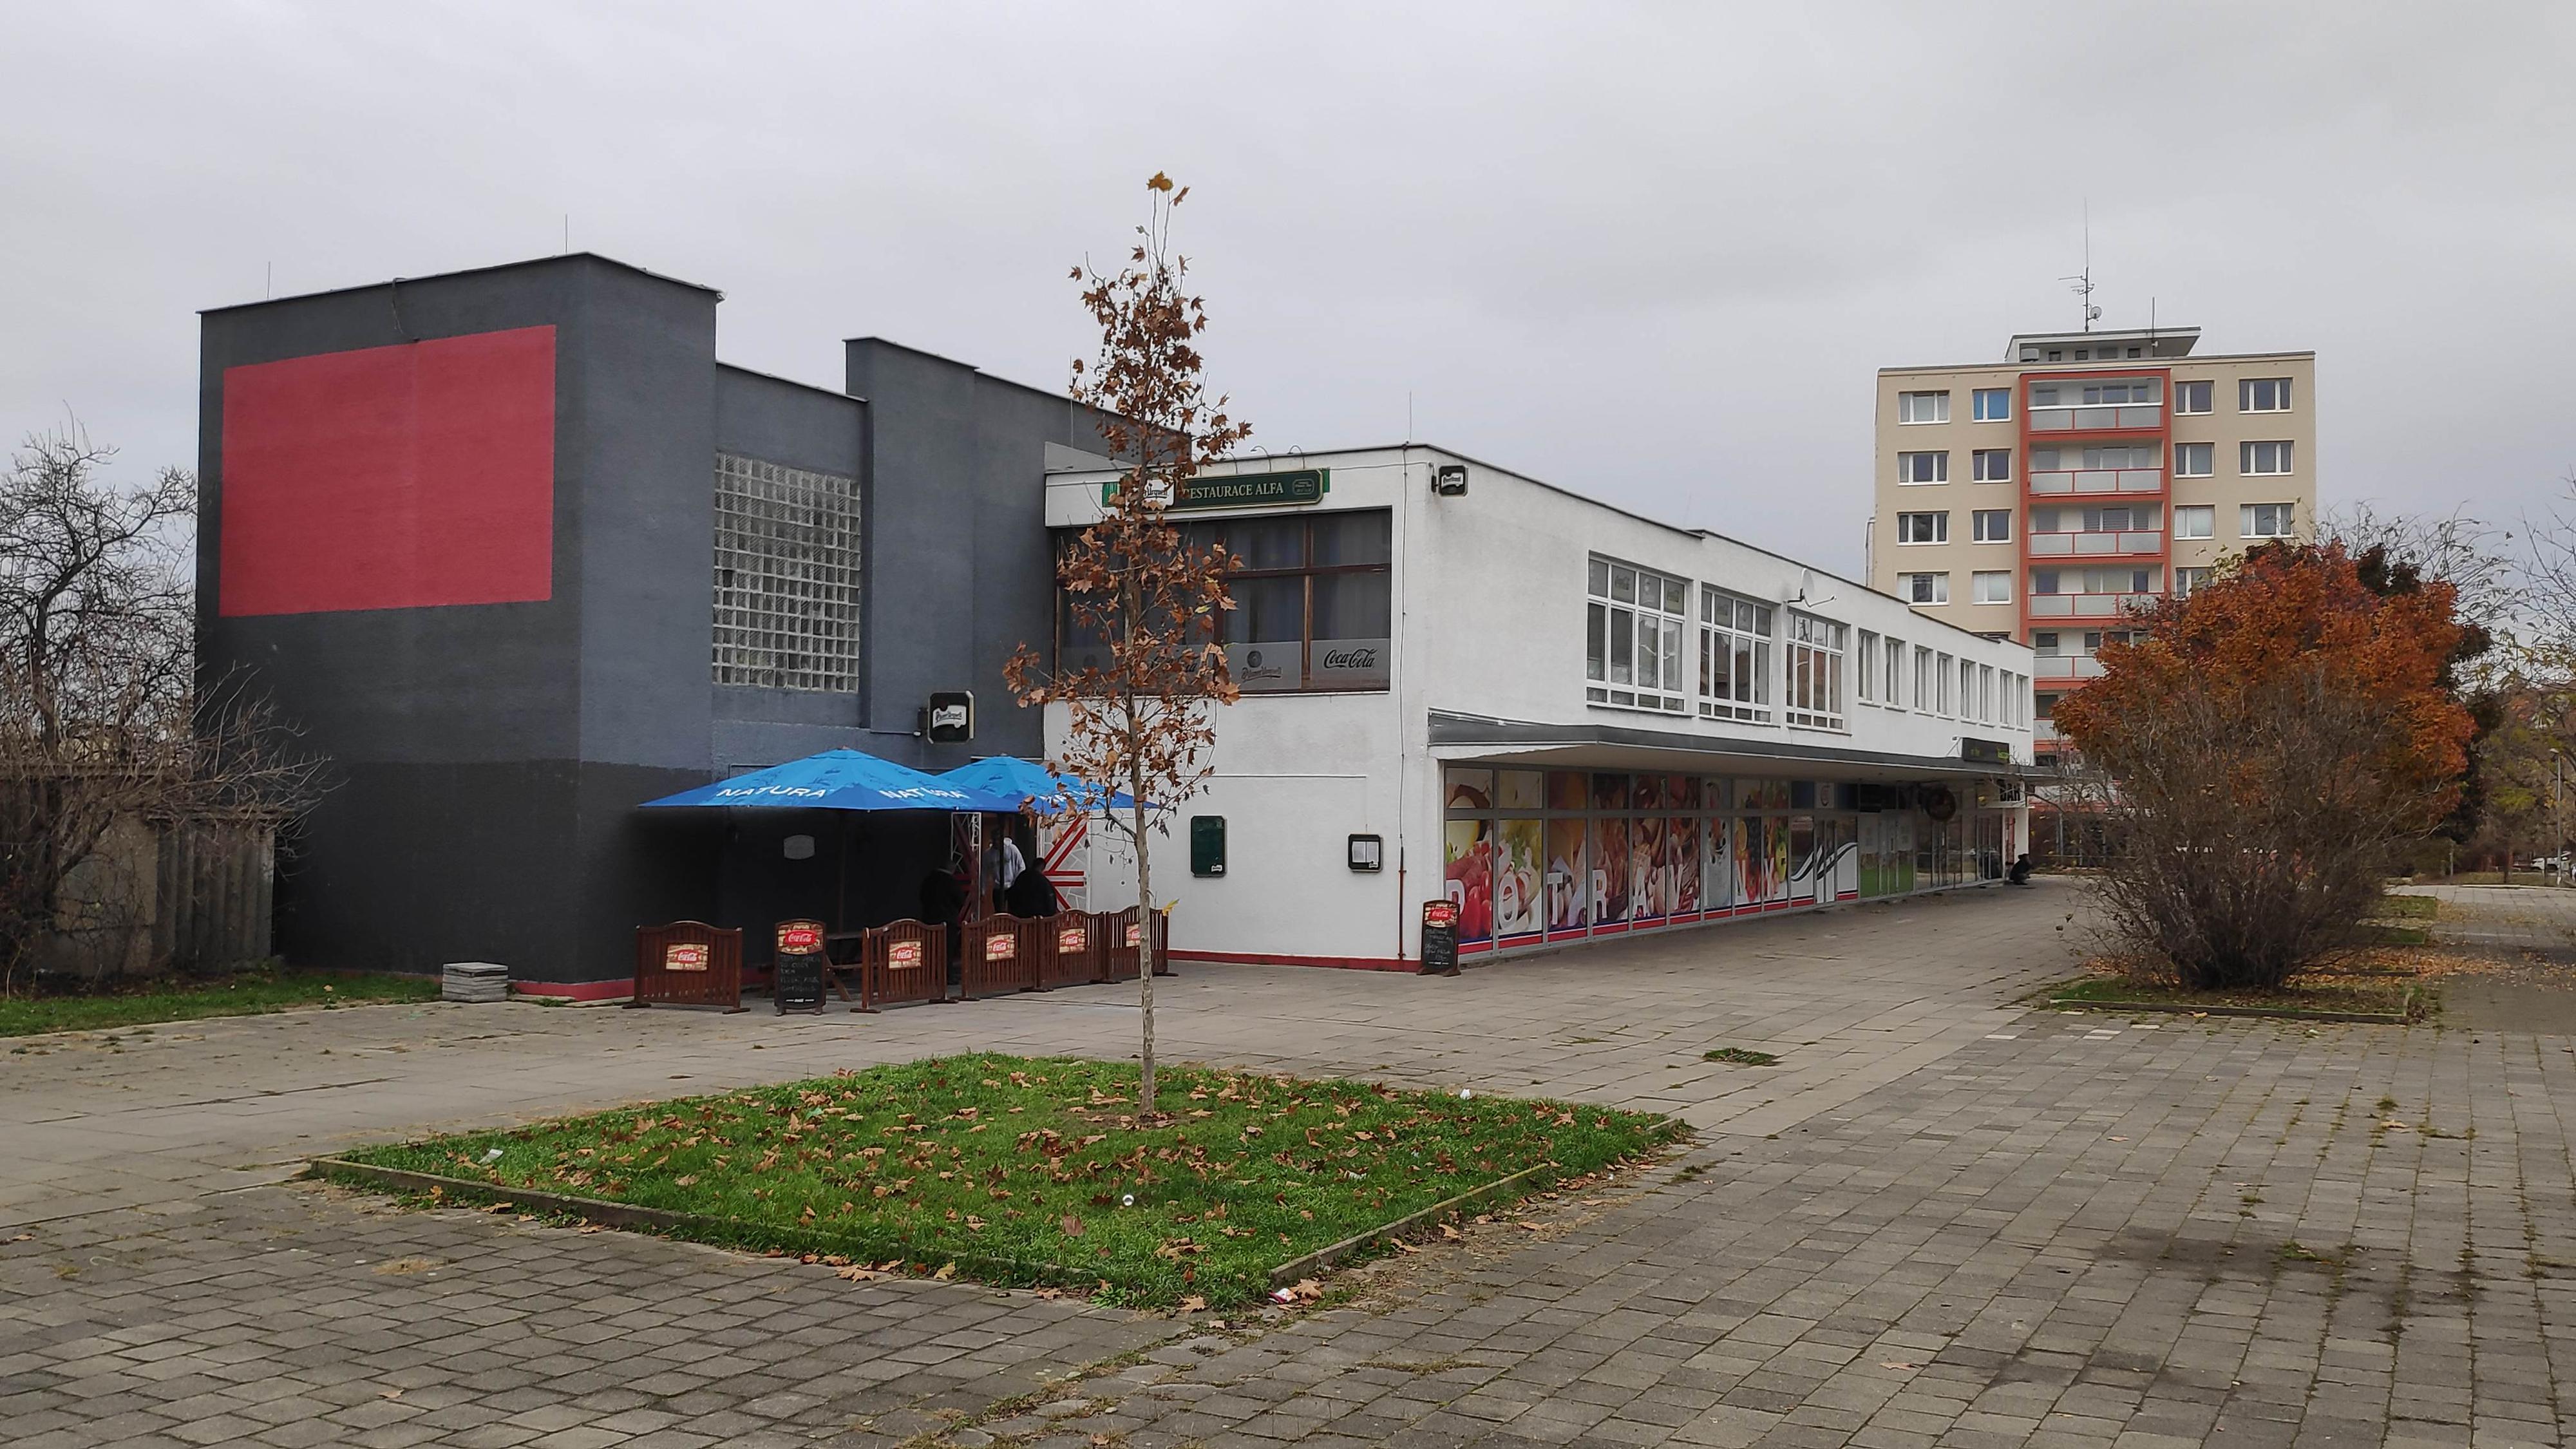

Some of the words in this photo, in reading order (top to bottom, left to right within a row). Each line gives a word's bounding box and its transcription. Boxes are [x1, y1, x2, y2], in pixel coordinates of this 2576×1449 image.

[1255, 482, 1284, 496] ALFA
[716, 785, 826, 798] NATURA
[878, 786, 971, 799] NATURA
